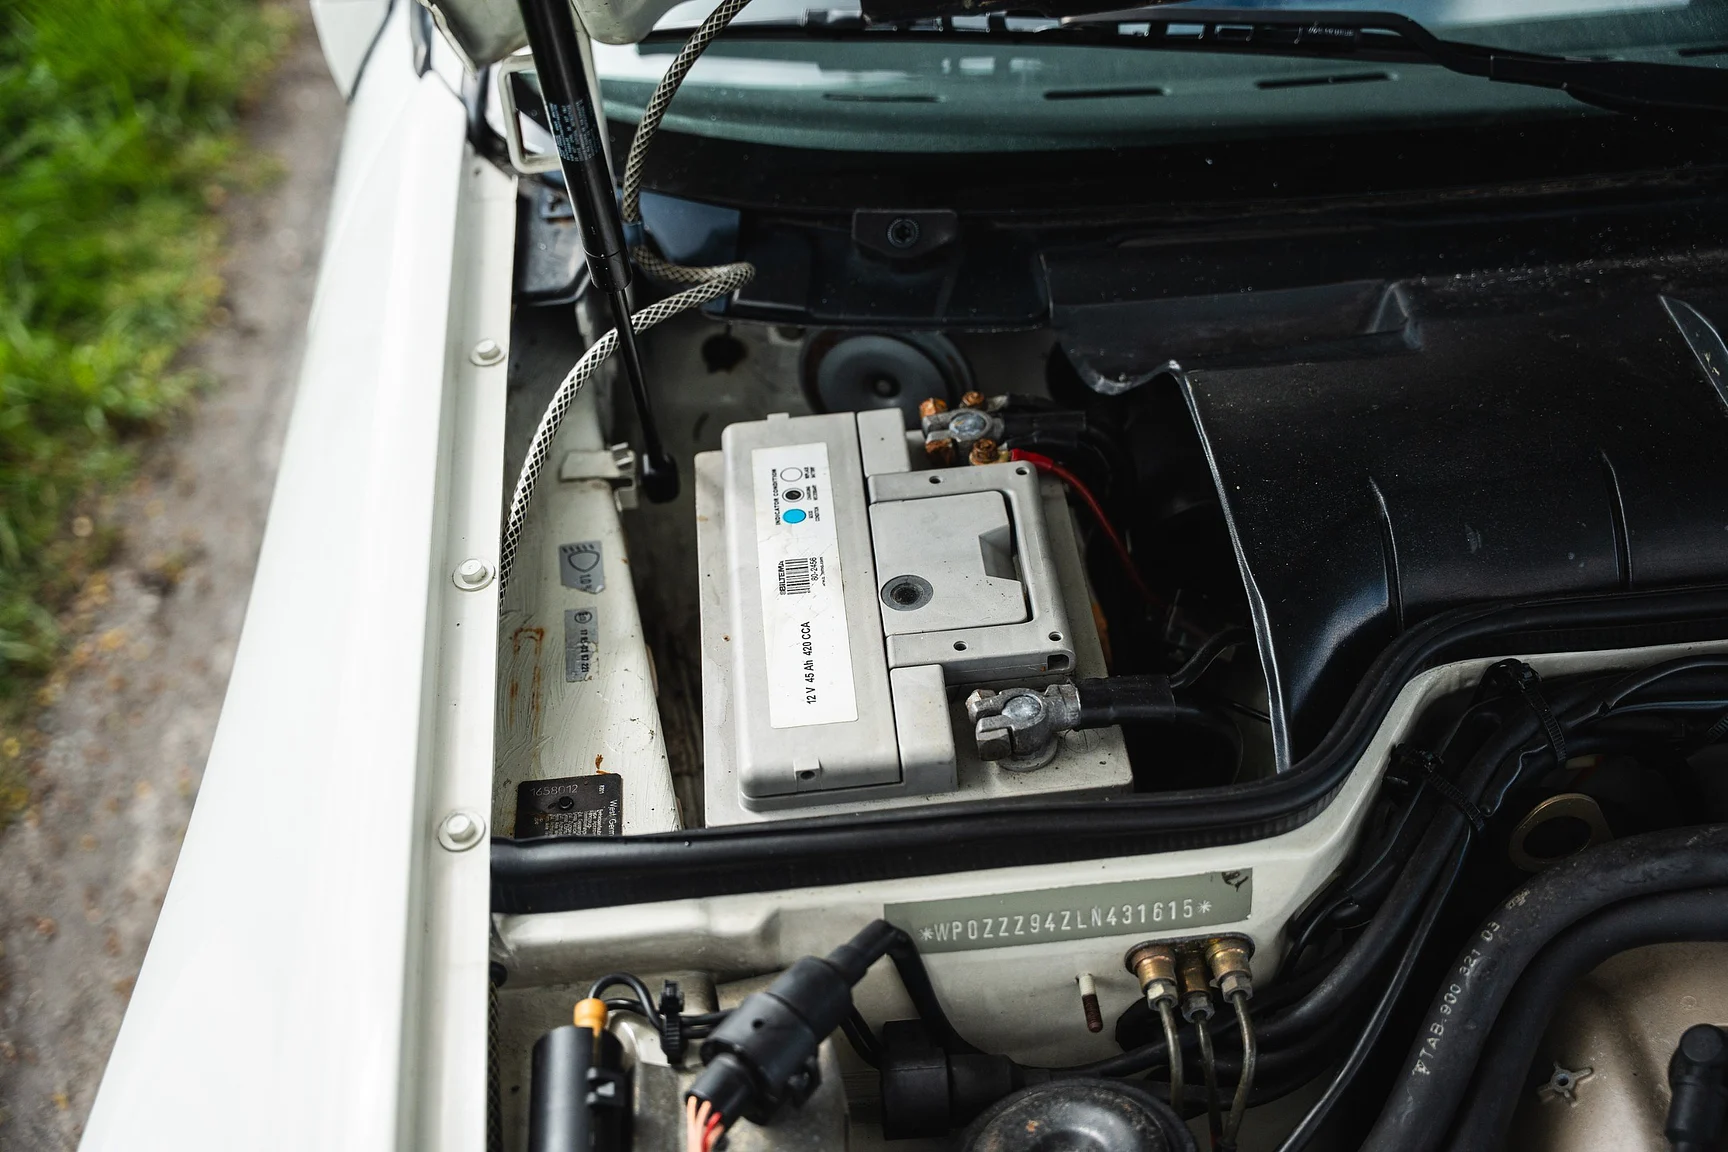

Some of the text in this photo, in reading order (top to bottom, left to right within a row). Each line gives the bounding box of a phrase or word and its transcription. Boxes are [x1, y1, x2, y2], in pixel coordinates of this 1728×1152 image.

[778, 560, 786, 595] BILTEMA
[801, 621, 816, 704] 12 V 45 Ah 420 CCA
[530, 784, 578, 796] 1658012
[1480, 922, 1500, 942] 03
